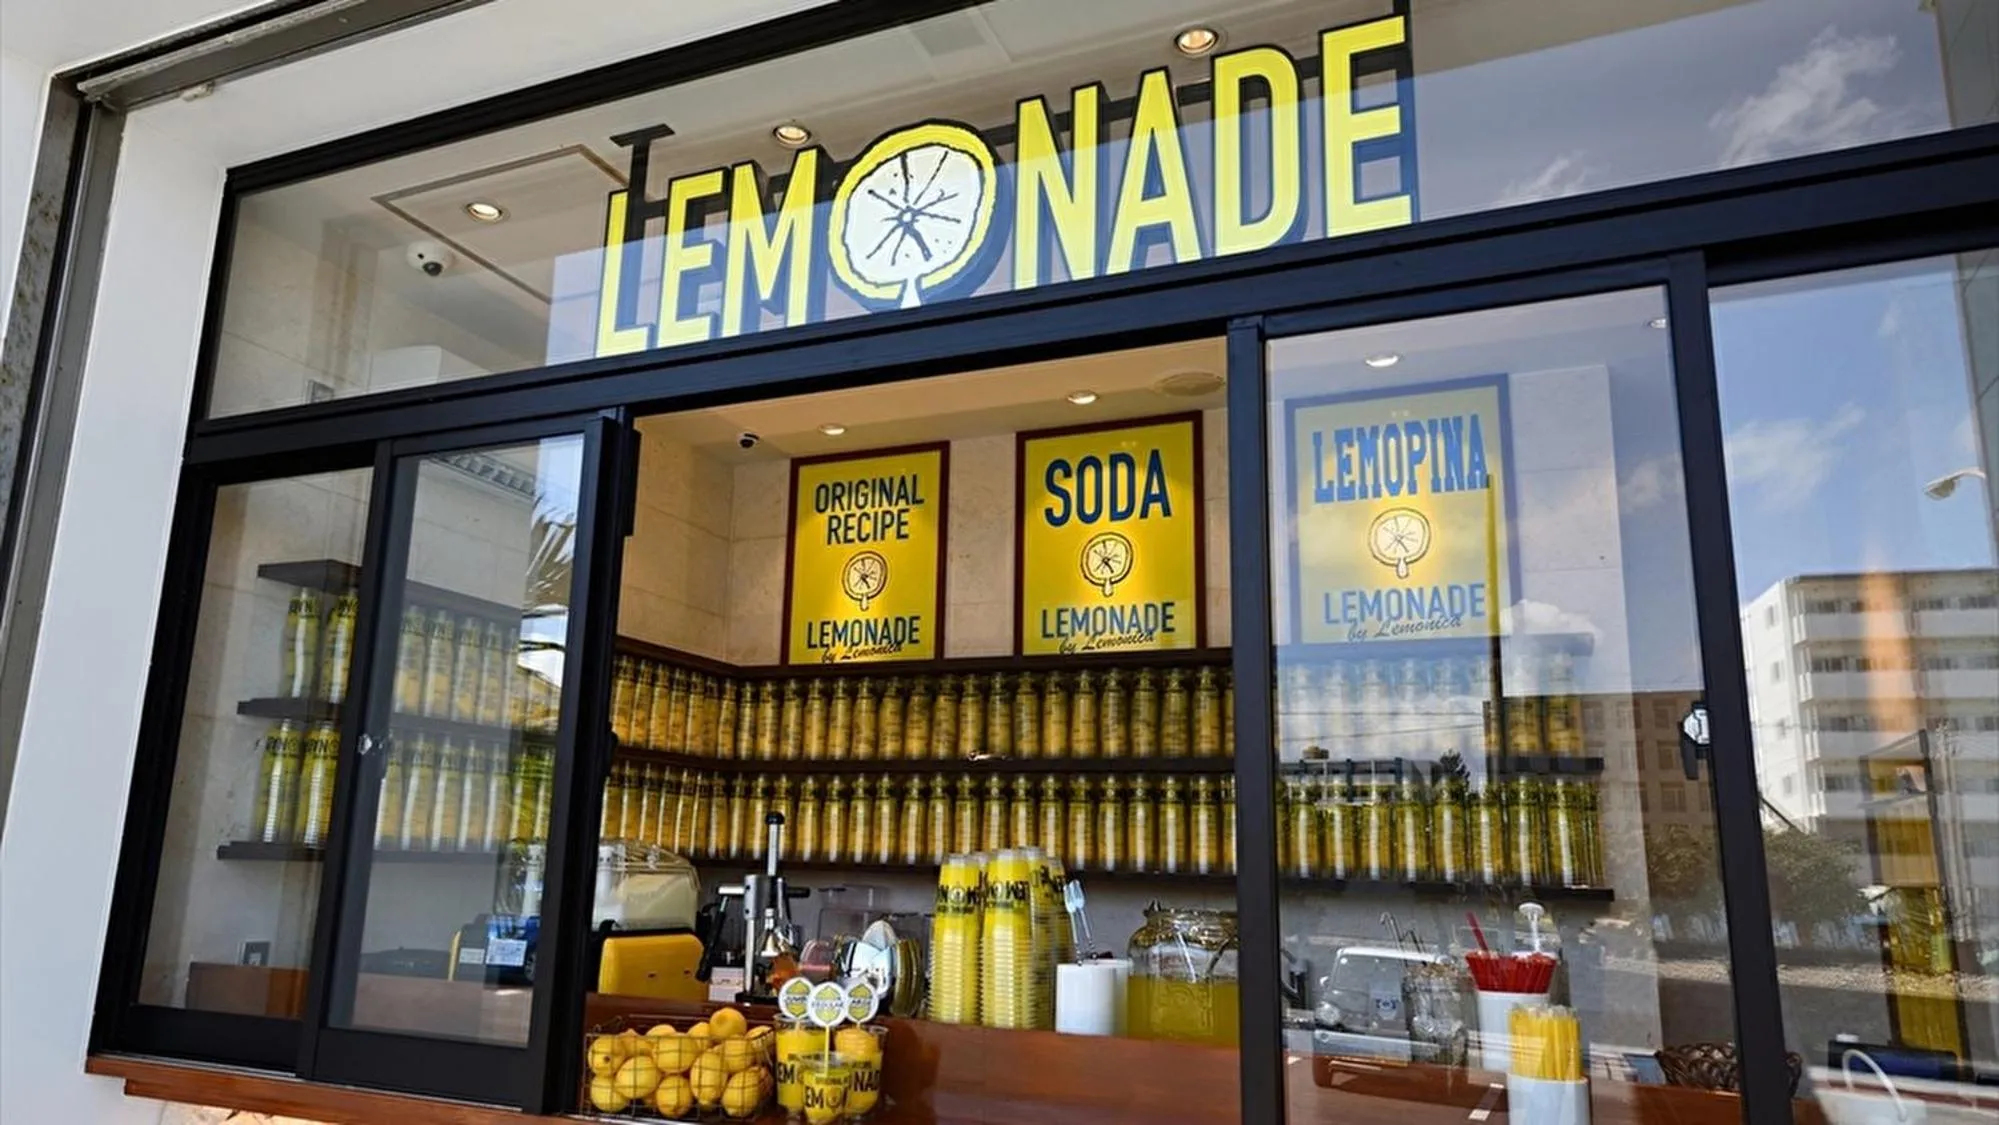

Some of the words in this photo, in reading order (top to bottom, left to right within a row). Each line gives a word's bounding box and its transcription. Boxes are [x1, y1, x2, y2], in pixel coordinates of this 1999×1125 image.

[595, 15, 1412, 358] LEMONADE
[1312, 413, 1490, 504] LEMOPINA
[814, 473, 925, 514] ORIGINAL
[1044, 448, 1173, 528] SODA
[826, 508, 910, 545] RECIPE
[1042, 602, 1175, 639] LEMONADE
[1324, 583, 1485, 625] LEMONADE
[807, 615, 921, 649] LEMONADE
[1059, 637, 1077, 654] by
[1346, 615, 1369, 642] by
